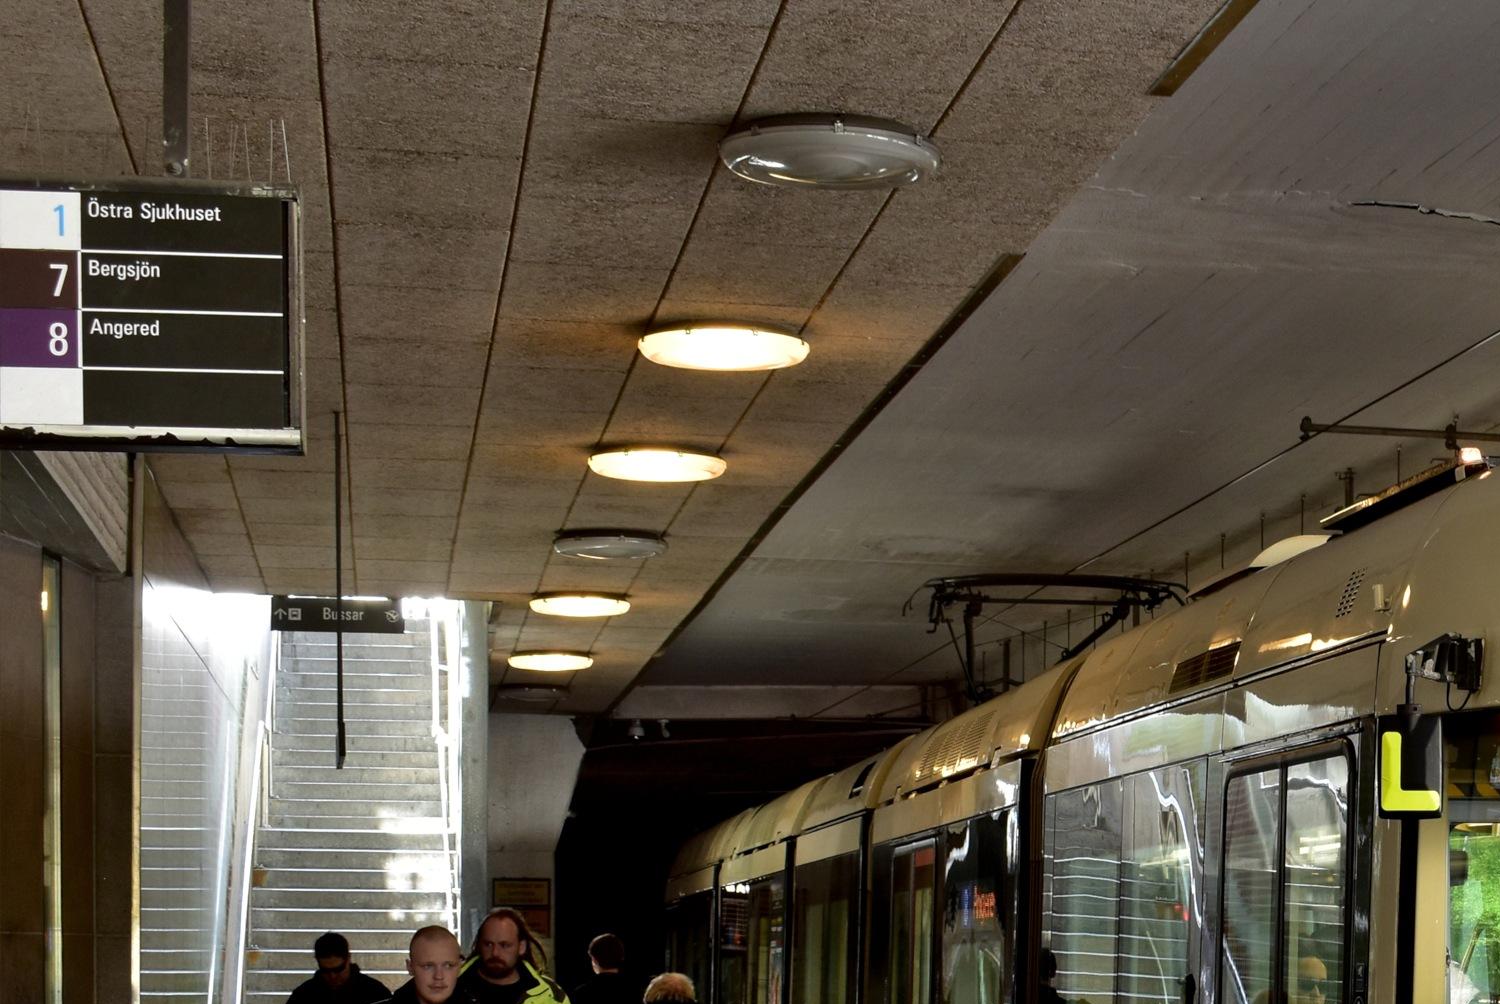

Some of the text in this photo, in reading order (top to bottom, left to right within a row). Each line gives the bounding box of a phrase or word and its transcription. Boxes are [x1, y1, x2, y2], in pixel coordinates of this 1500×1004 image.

[53, 197, 221, 237] 1 Östra Sjukhuset
[49, 260, 161, 297] 7 Bergsjön
[49, 318, 160, 356] 8 Angered
